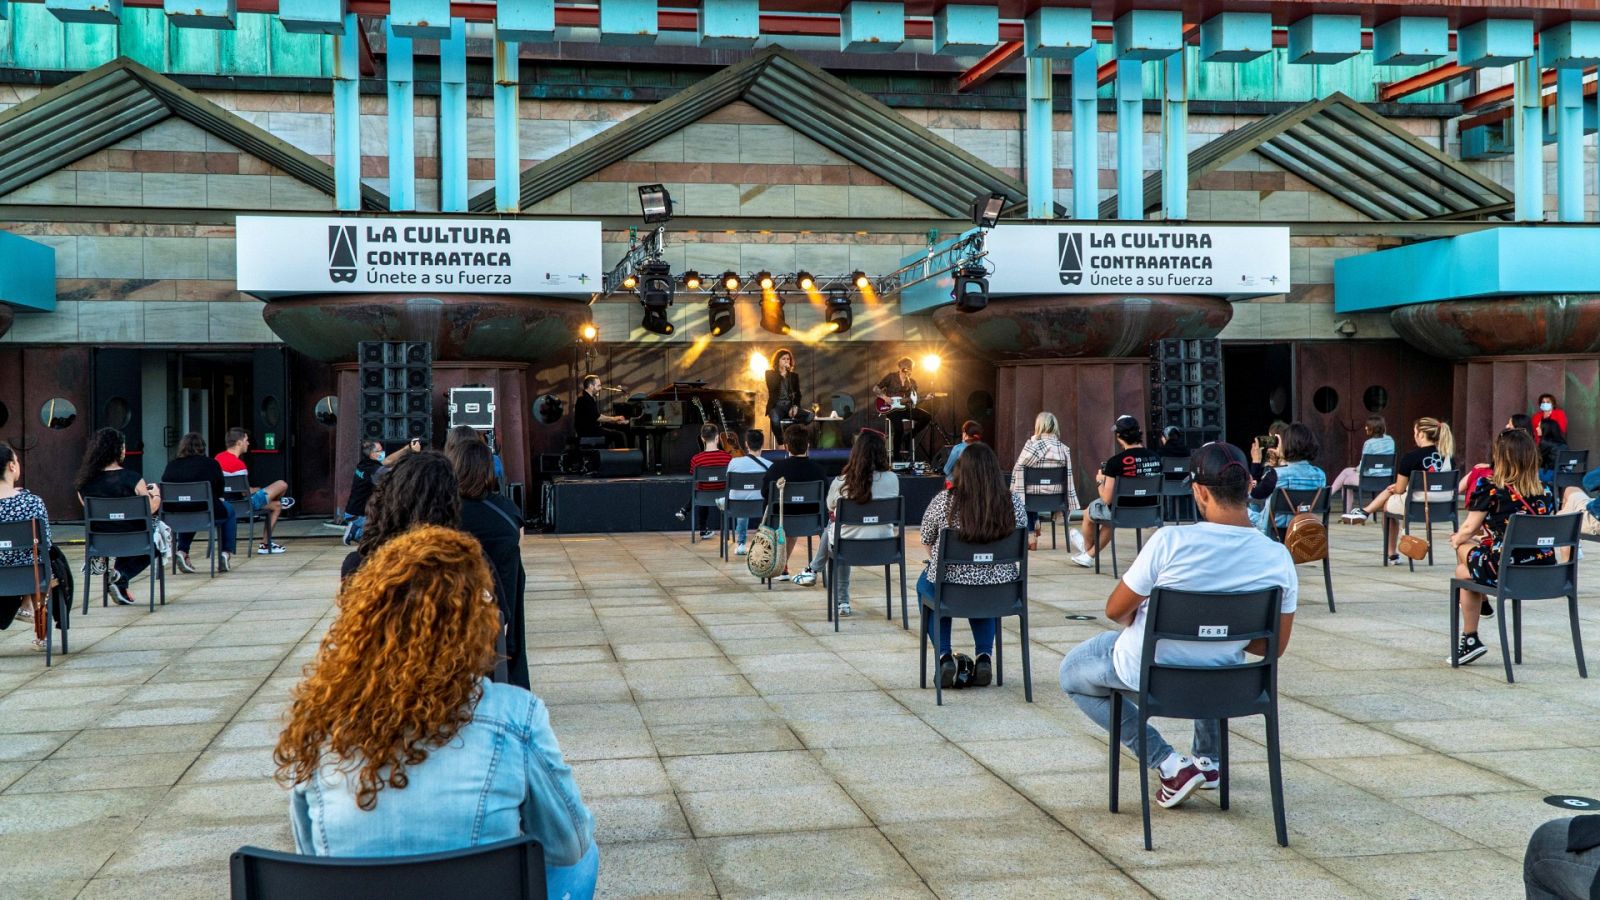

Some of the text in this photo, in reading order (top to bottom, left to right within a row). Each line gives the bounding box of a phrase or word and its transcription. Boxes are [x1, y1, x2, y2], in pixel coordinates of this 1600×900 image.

[366, 226, 511, 244] LA CULTURA
[1090, 232, 1212, 249] LA CULTURA
[367, 250, 511, 266] CONTRAATACA
[1090, 255, 1213, 269] CONTRAATACA
[366, 267, 512, 285] Únete a su fuerza
[1090, 270, 1213, 286] Únete a su fuerza
